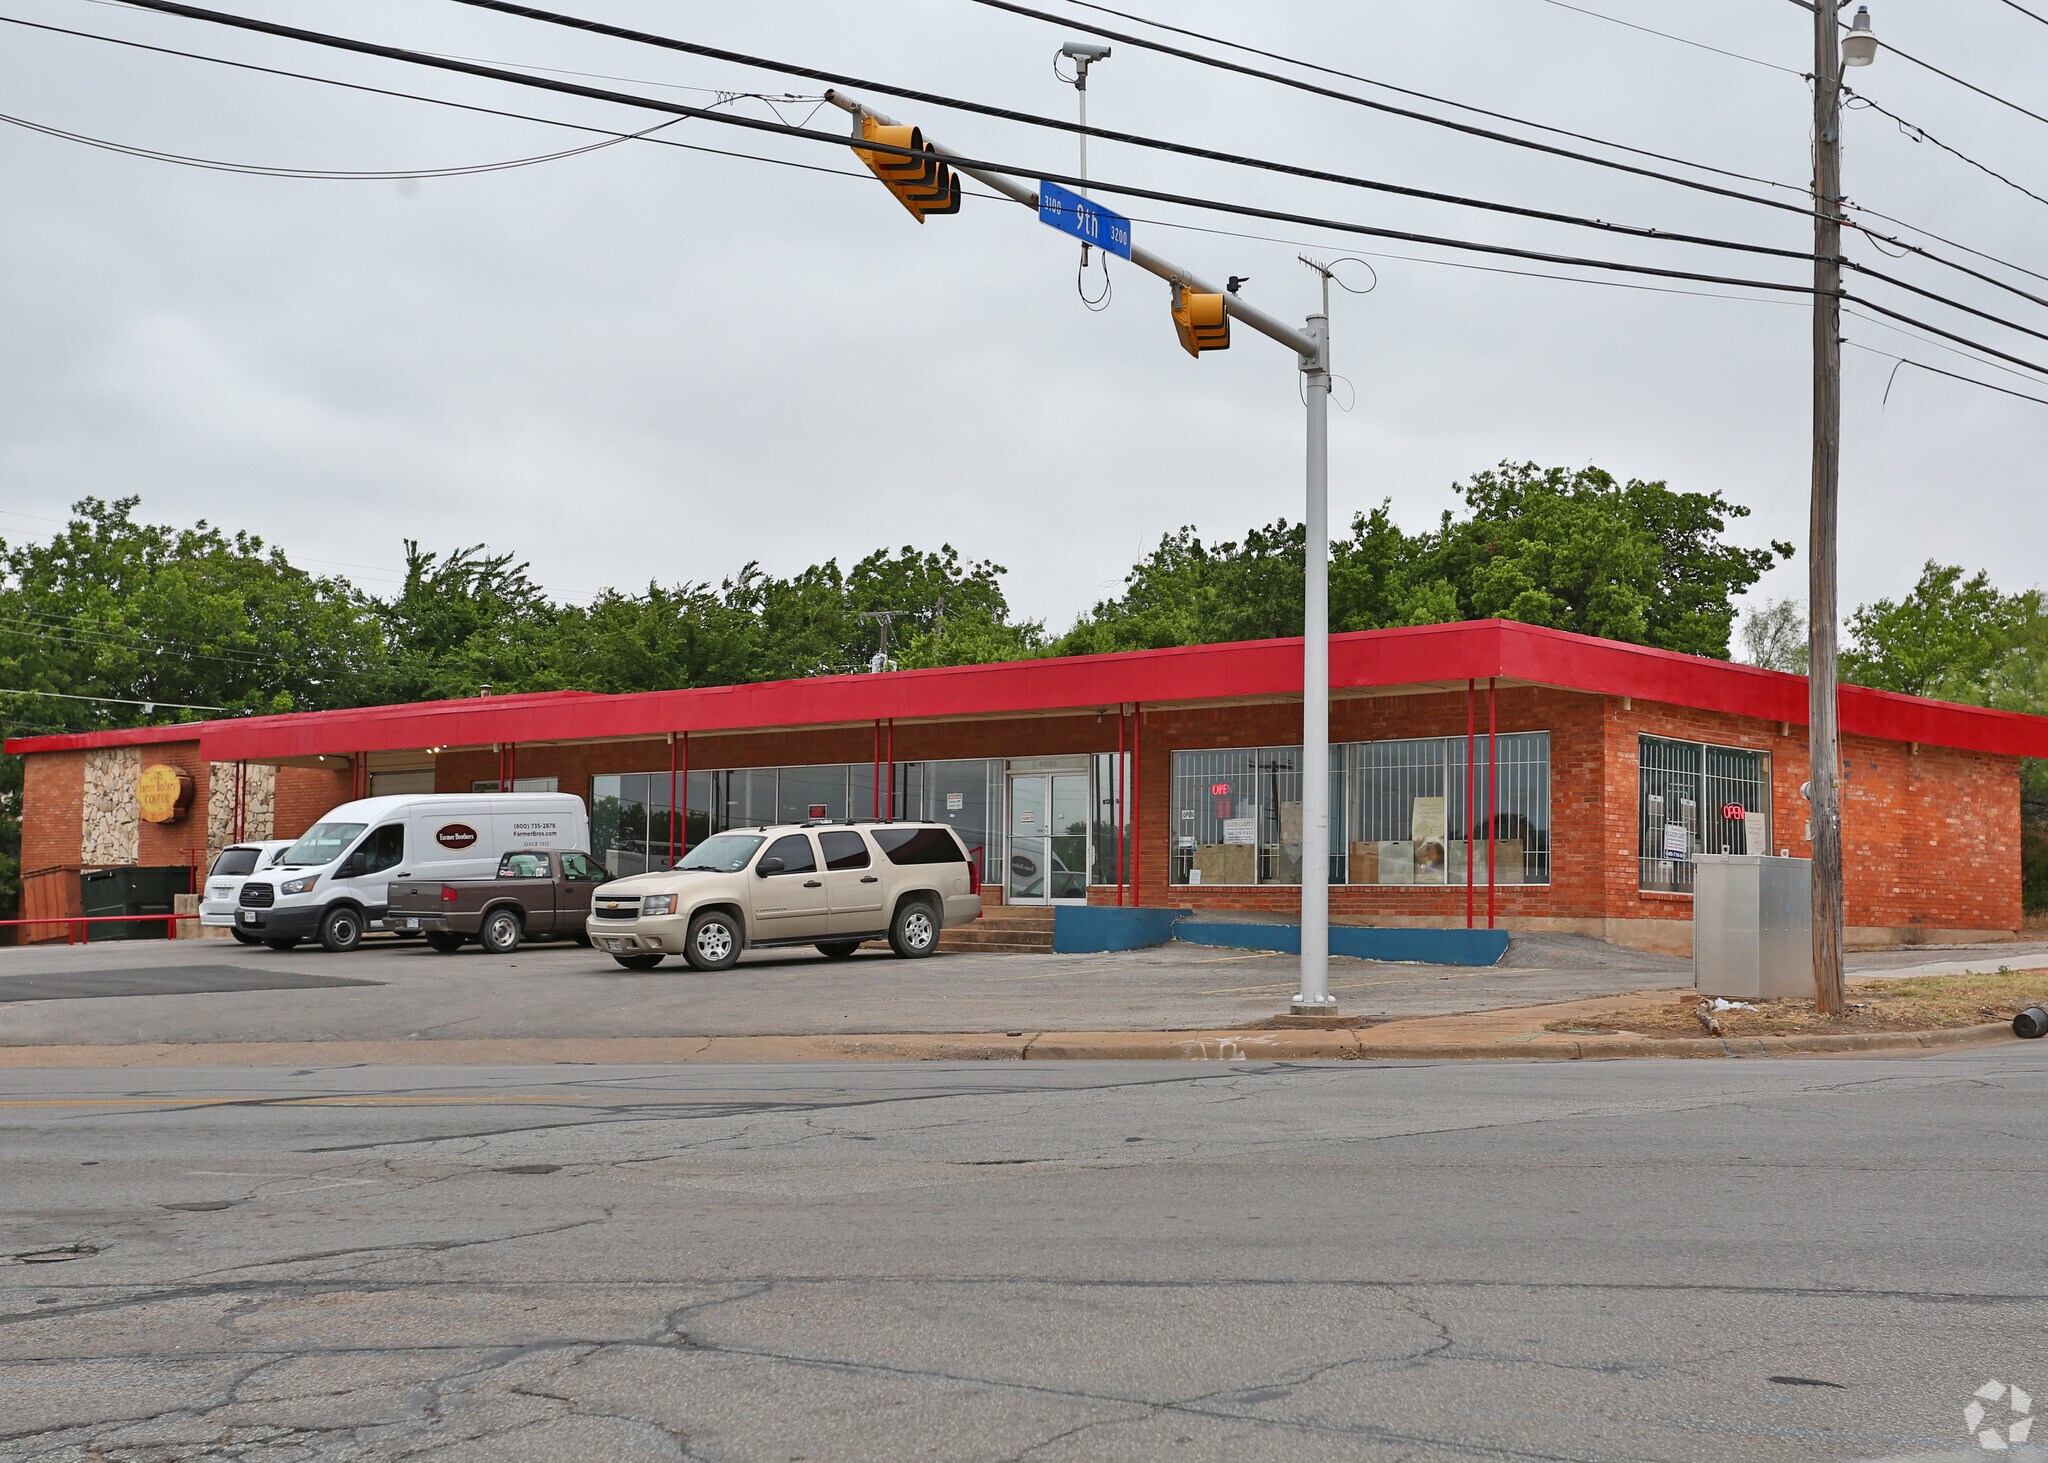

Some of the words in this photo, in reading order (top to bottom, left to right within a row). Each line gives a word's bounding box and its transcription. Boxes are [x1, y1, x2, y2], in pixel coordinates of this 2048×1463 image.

[1044, 195, 1062, 215] 3100
[1076, 203, 1098, 239] 9th
[1110, 225, 1128, 246] 3200
[1723, 805, 1745, 820] OPEN
[439, 833, 454, 841] Farmer
[455, 832, 474, 840] Brothers
